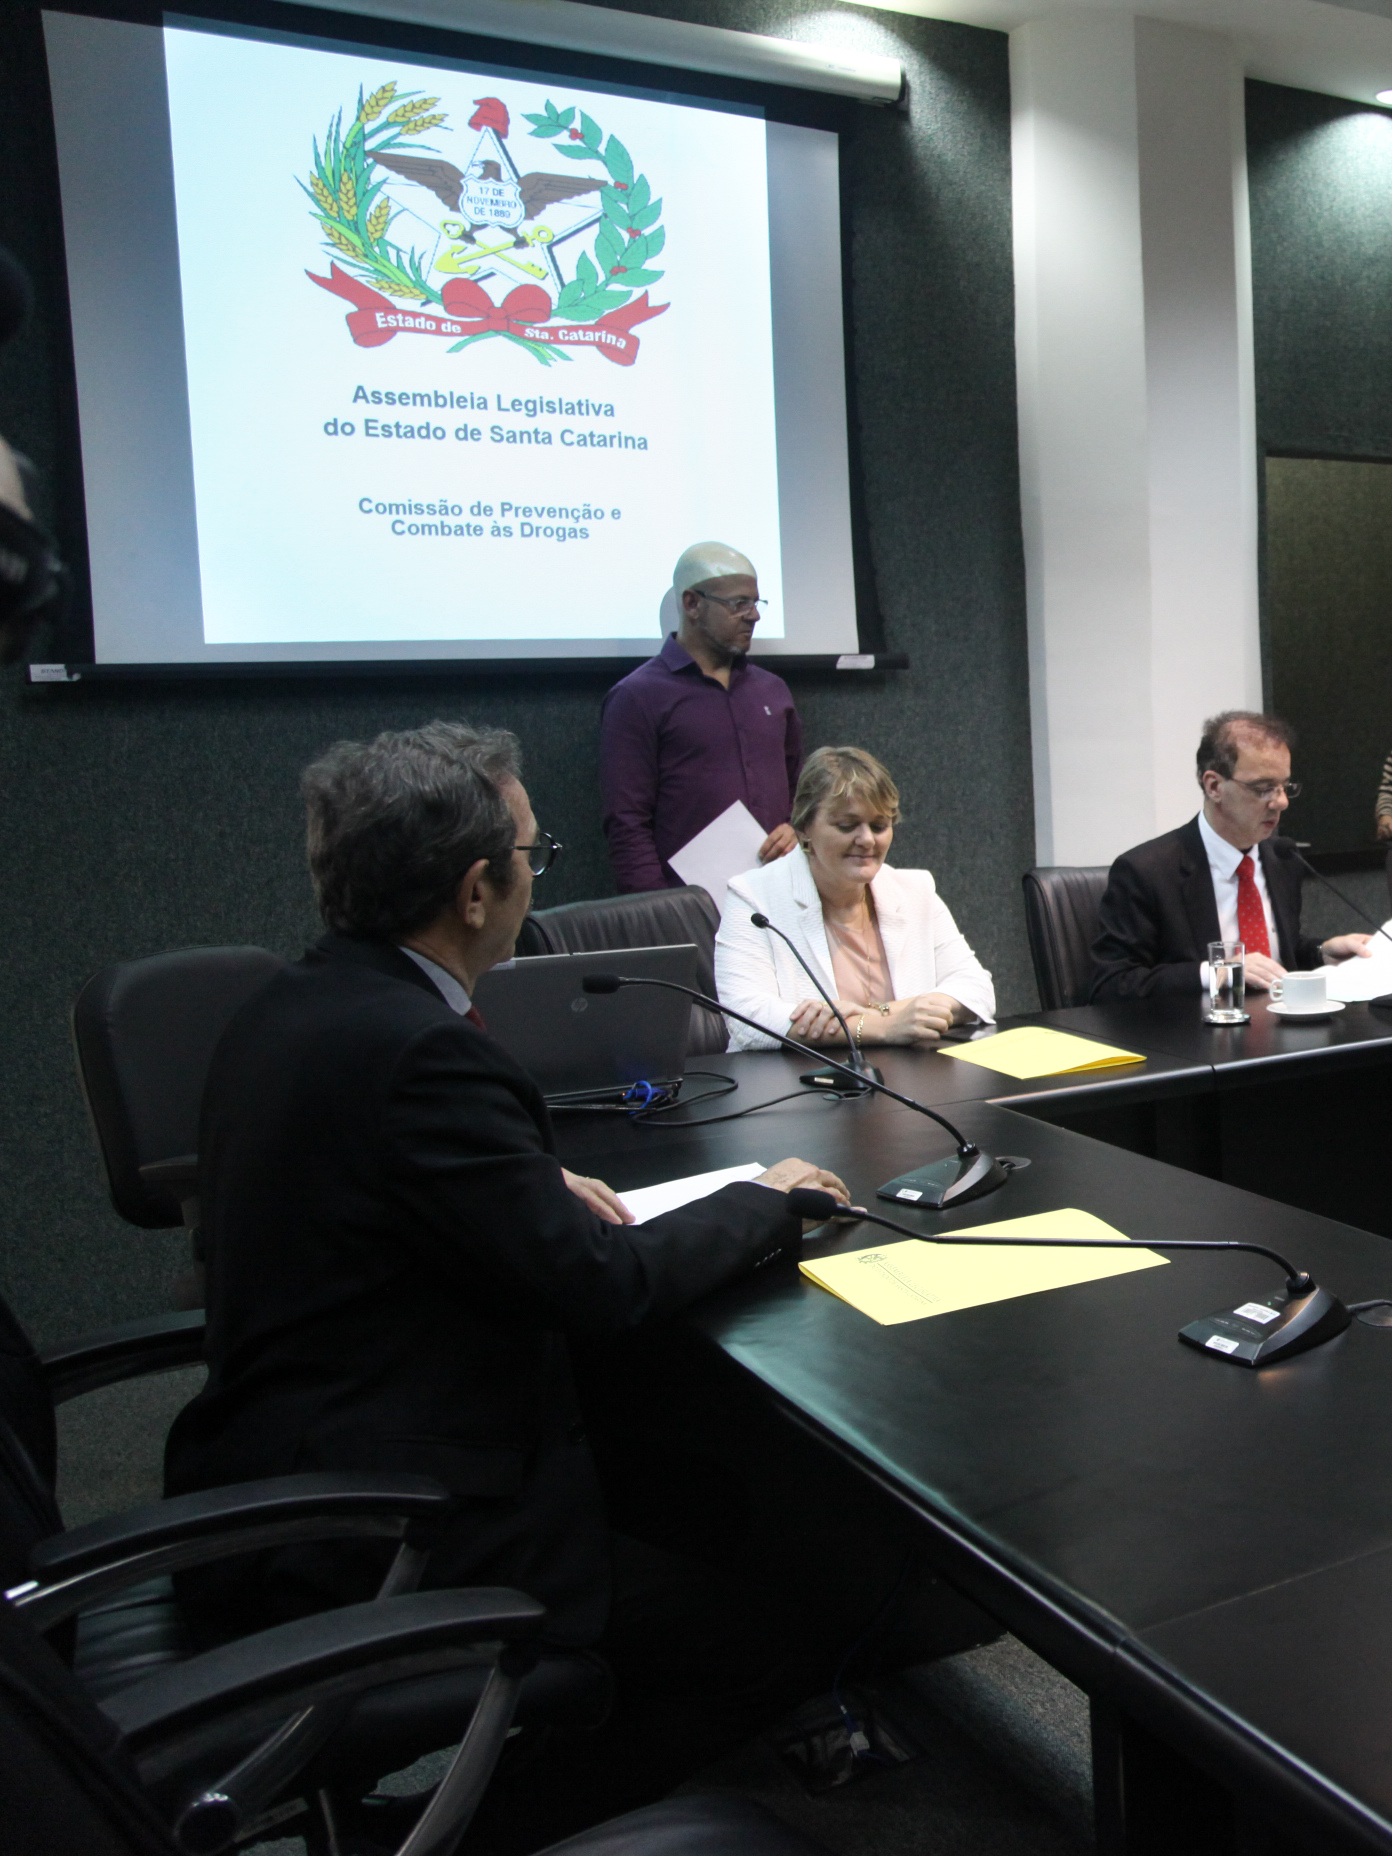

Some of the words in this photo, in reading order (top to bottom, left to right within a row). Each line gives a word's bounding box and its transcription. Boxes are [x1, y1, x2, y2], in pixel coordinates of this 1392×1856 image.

[479, 186, 490, 195] 17
[492, 188, 505, 197] DE
[474, 207, 486, 216] DE
[375, 312, 437, 331] Estado
[441, 316, 462, 334] de
[524, 328, 555, 341] Sta.
[558, 329, 627, 349] Catarina
[352, 385, 489, 411] Assembleia
[497, 394, 615, 418] Legislativa
[323, 418, 356, 437] do
[364, 419, 447, 441] Estado
[455, 424, 482, 442] de
[490, 425, 553, 446] Santa
[560, 429, 649, 451] Catarina
[359, 498, 463, 517] Comissão
[470, 501, 494, 518] de
[501, 502, 605, 524] Prevenção
[611, 509, 622, 521] e
[391, 520, 484, 537] Combate
[491, 521, 513, 538] às
[520, 522, 590, 543] Drogas
